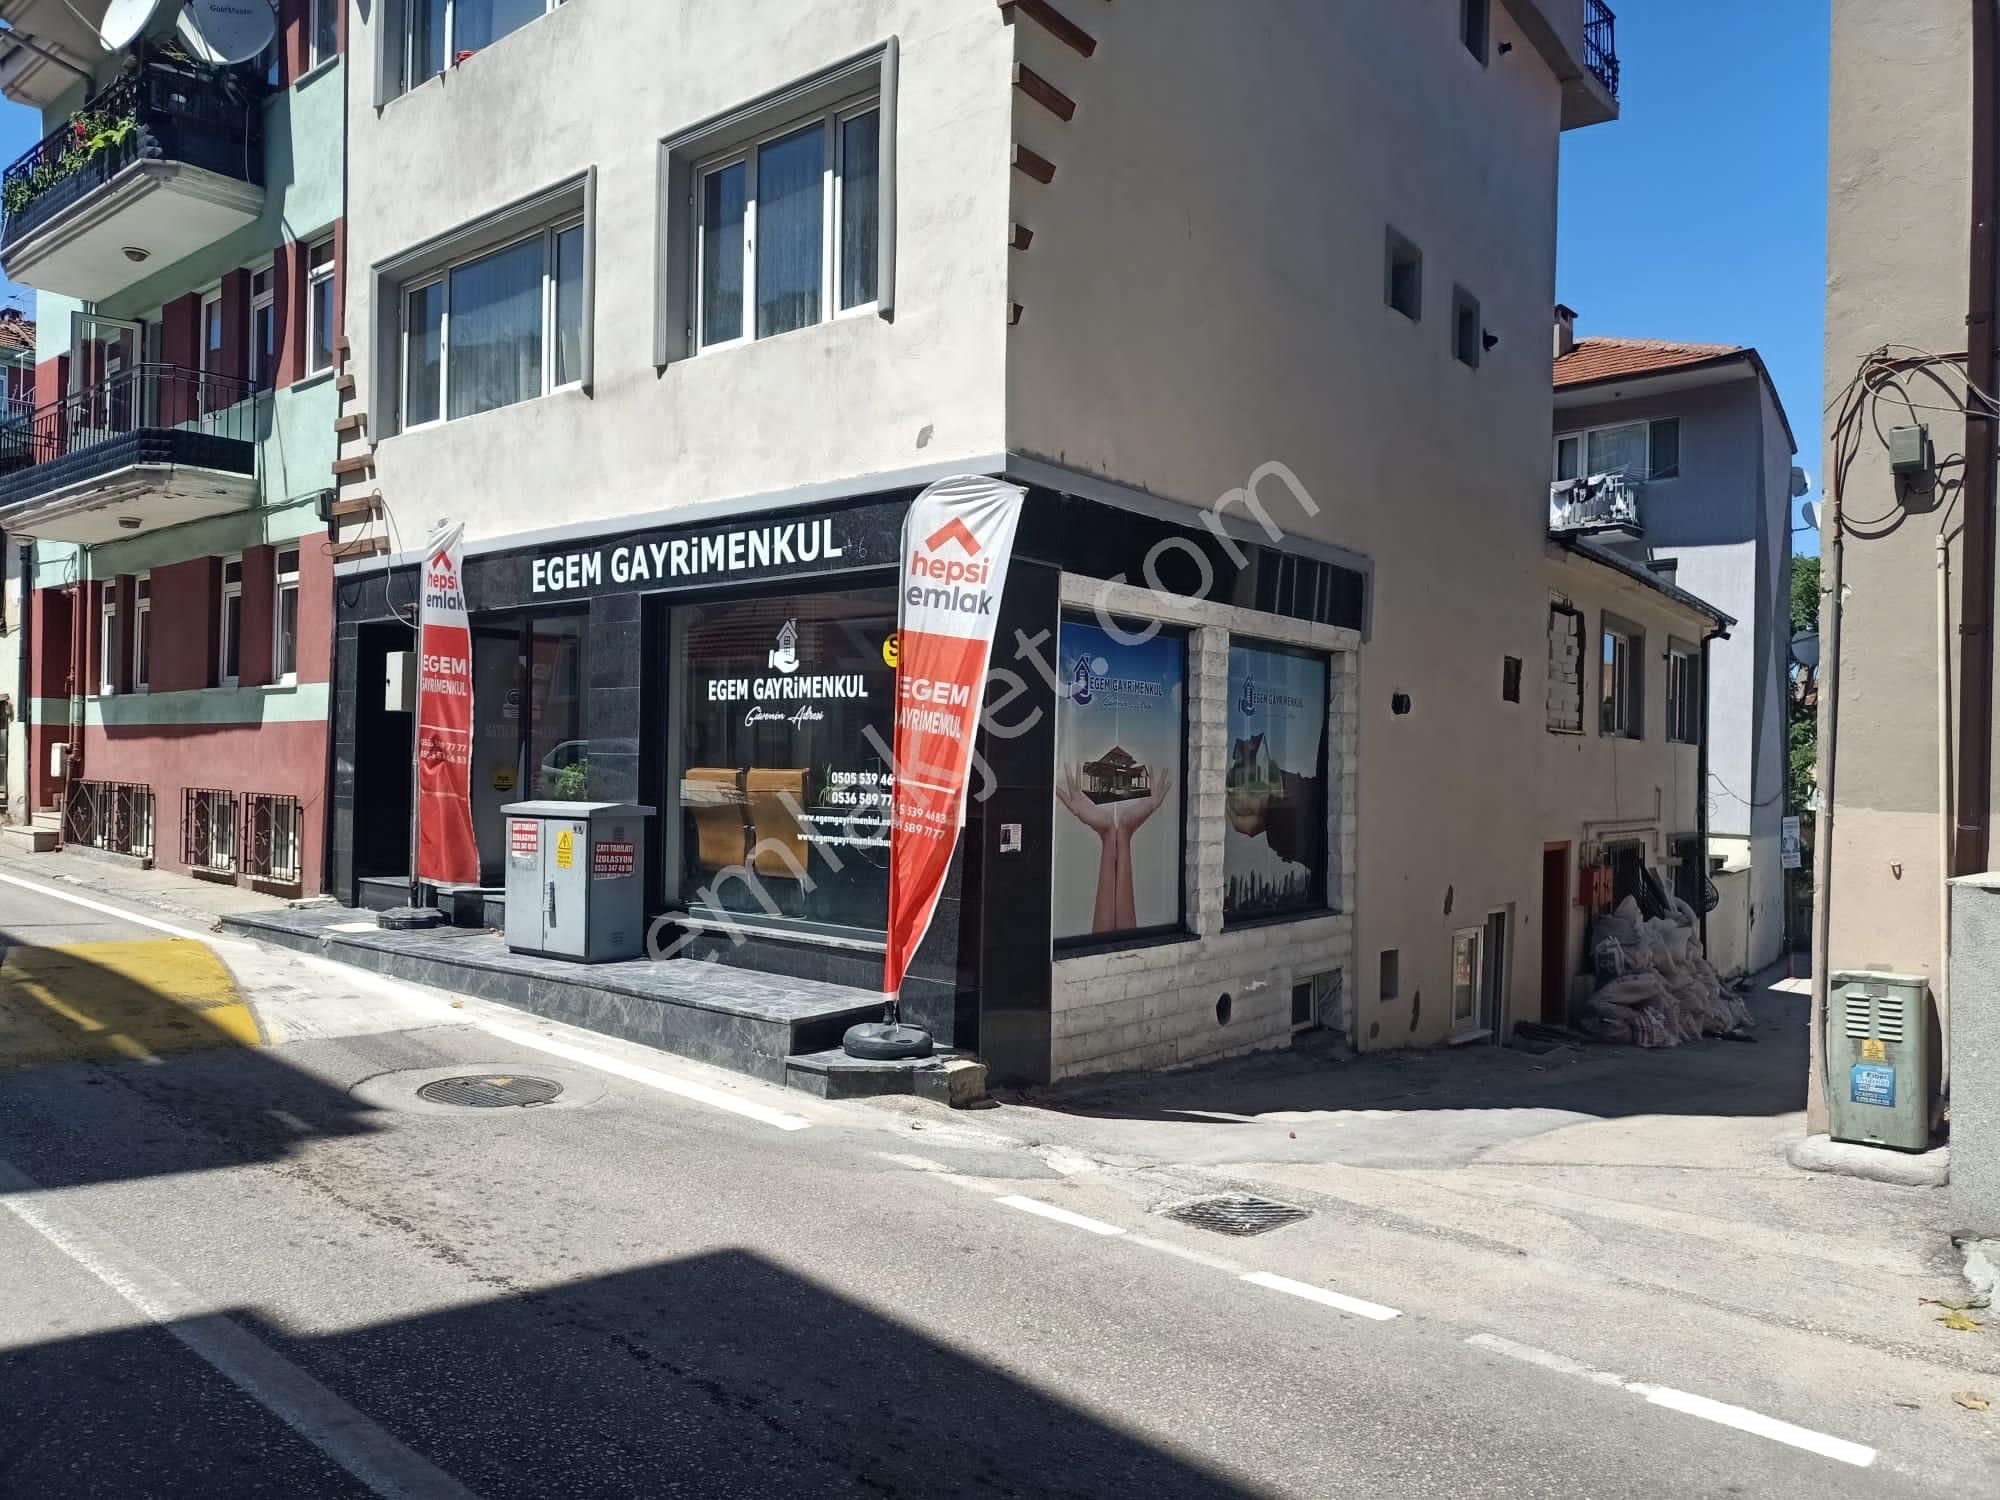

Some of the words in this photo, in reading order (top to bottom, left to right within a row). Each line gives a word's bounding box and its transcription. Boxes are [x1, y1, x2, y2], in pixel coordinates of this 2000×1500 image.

[532, 551, 602, 593] EGEM
[910, 551, 990, 586] hepsi
[426, 569, 459, 592] hepsi
[425, 591, 464, 610] emlak
[906, 584, 993, 616] emlak
[423, 654, 467, 676] EGEM
[708, 679, 749, 701] EGEM
[900, 675, 970, 708] EGEM
[1089, 676, 1111, 691] EGEM
[831, 771, 857, 784] 0505
[859, 772, 878, 785] 539
[831, 791, 857, 805] 0536
[859, 792, 879, 806] 589
